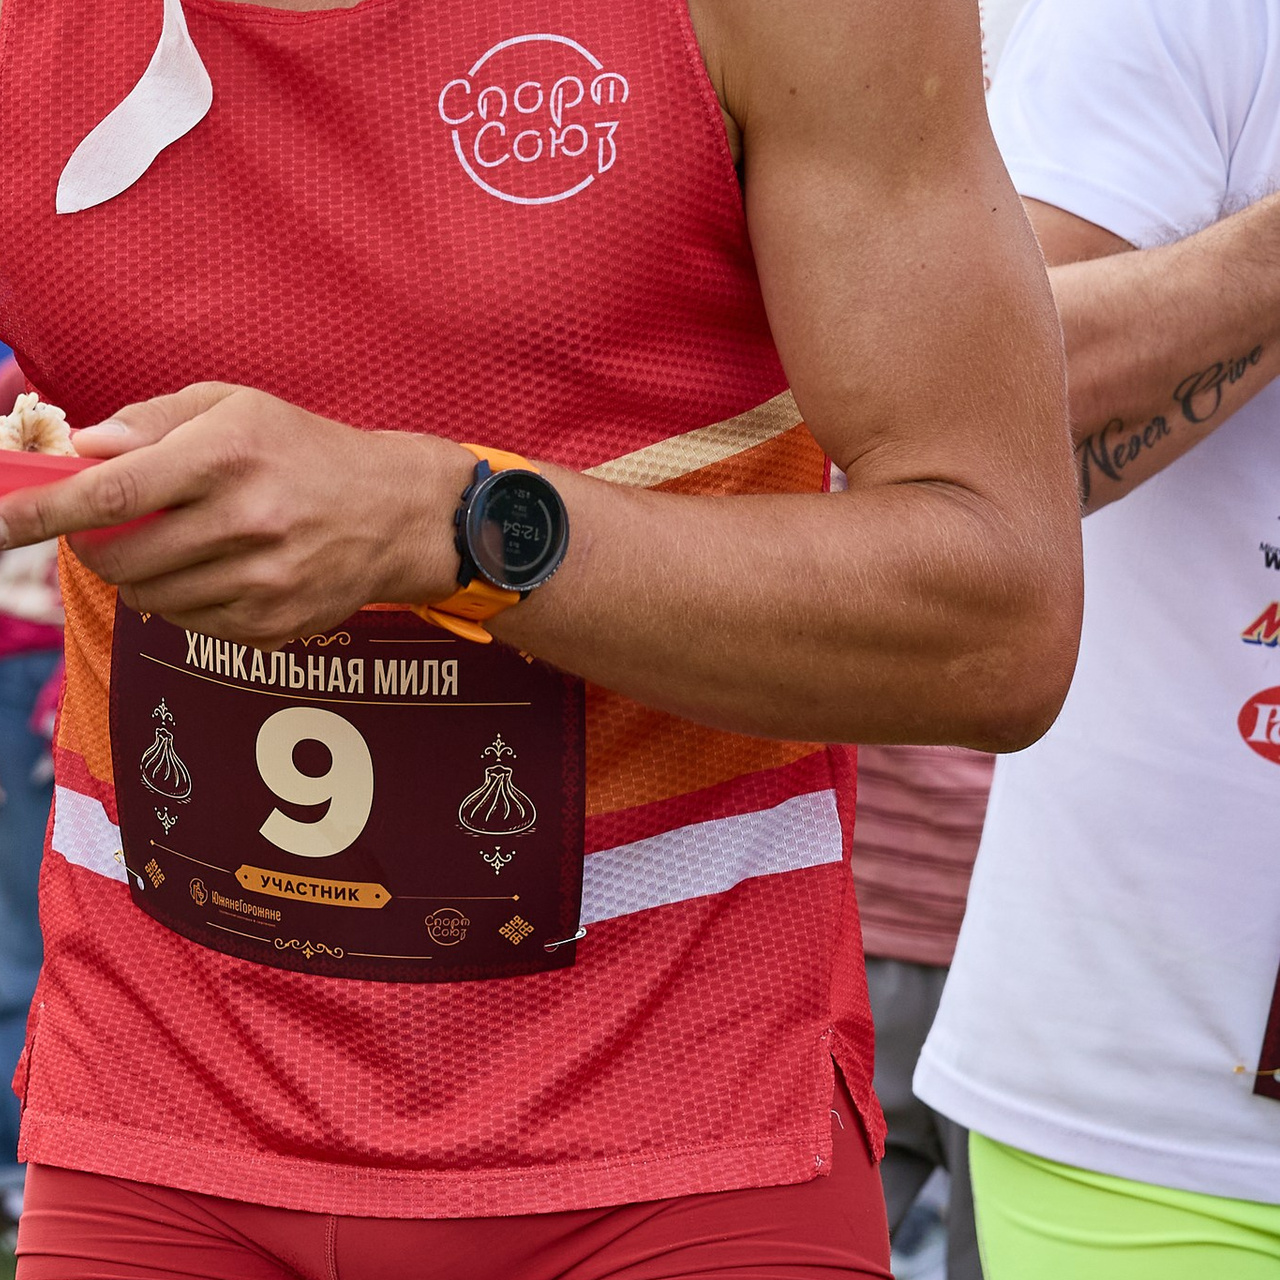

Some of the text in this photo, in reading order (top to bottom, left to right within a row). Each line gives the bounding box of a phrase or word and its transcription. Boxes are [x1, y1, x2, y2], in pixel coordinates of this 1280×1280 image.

[474, 121, 619, 174] Союз
[1076, 344, 1264, 506] Never Give
[502, 519, 540, 542] 12:54
[185, 629, 459, 696] ХИНКАЛЬНАЯ МИЛЯ
[255, 706, 375, 858] 9
[260, 874, 360, 902] УЧАСТНИК
